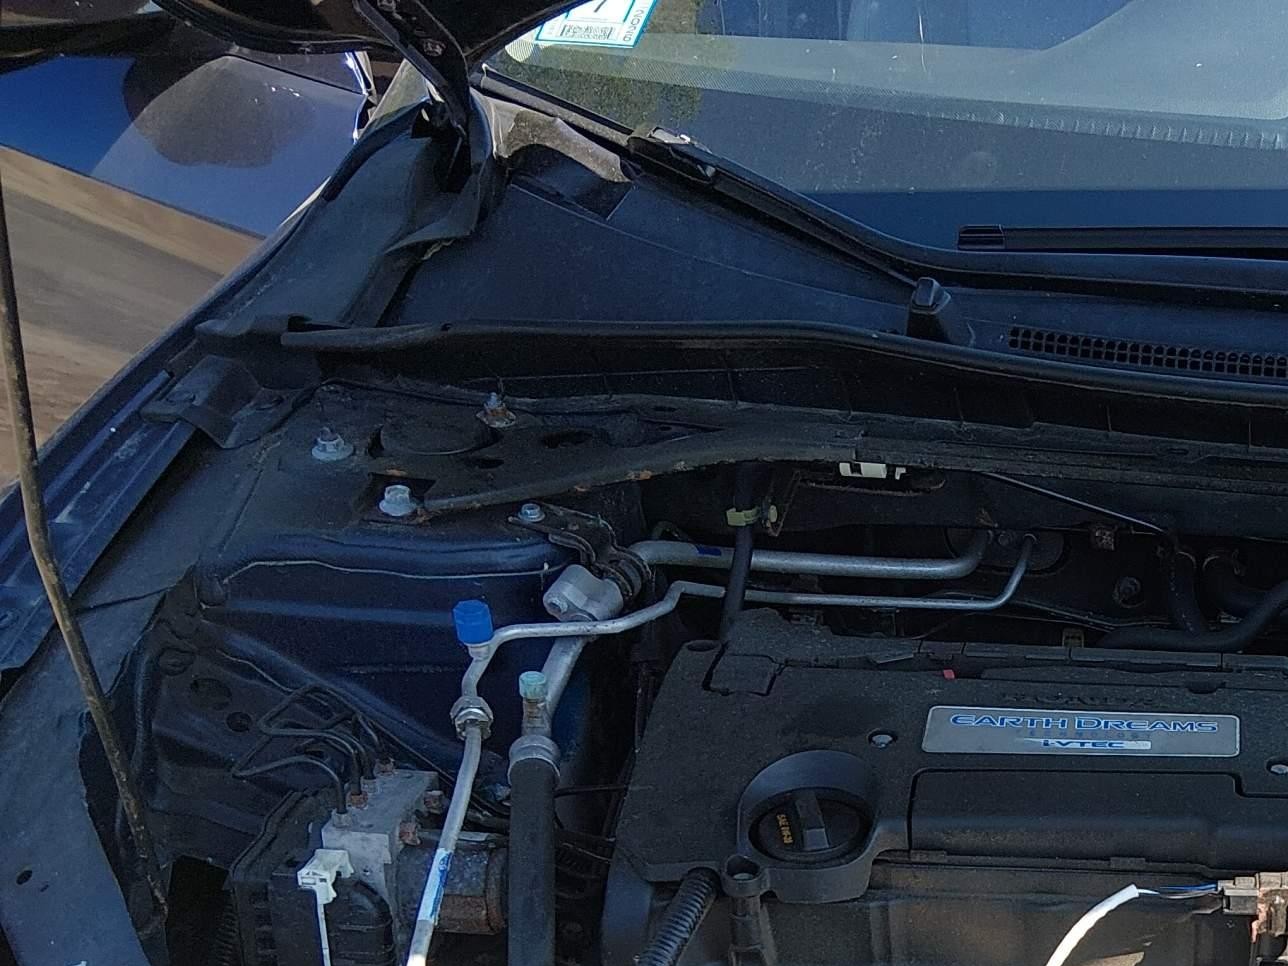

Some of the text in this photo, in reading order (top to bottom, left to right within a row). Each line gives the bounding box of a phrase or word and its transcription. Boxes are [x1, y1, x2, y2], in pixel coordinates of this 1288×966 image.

[950, 713, 1219, 733] EARTH DREAMS
[1041, 739, 1125, 749] i-VTEC
